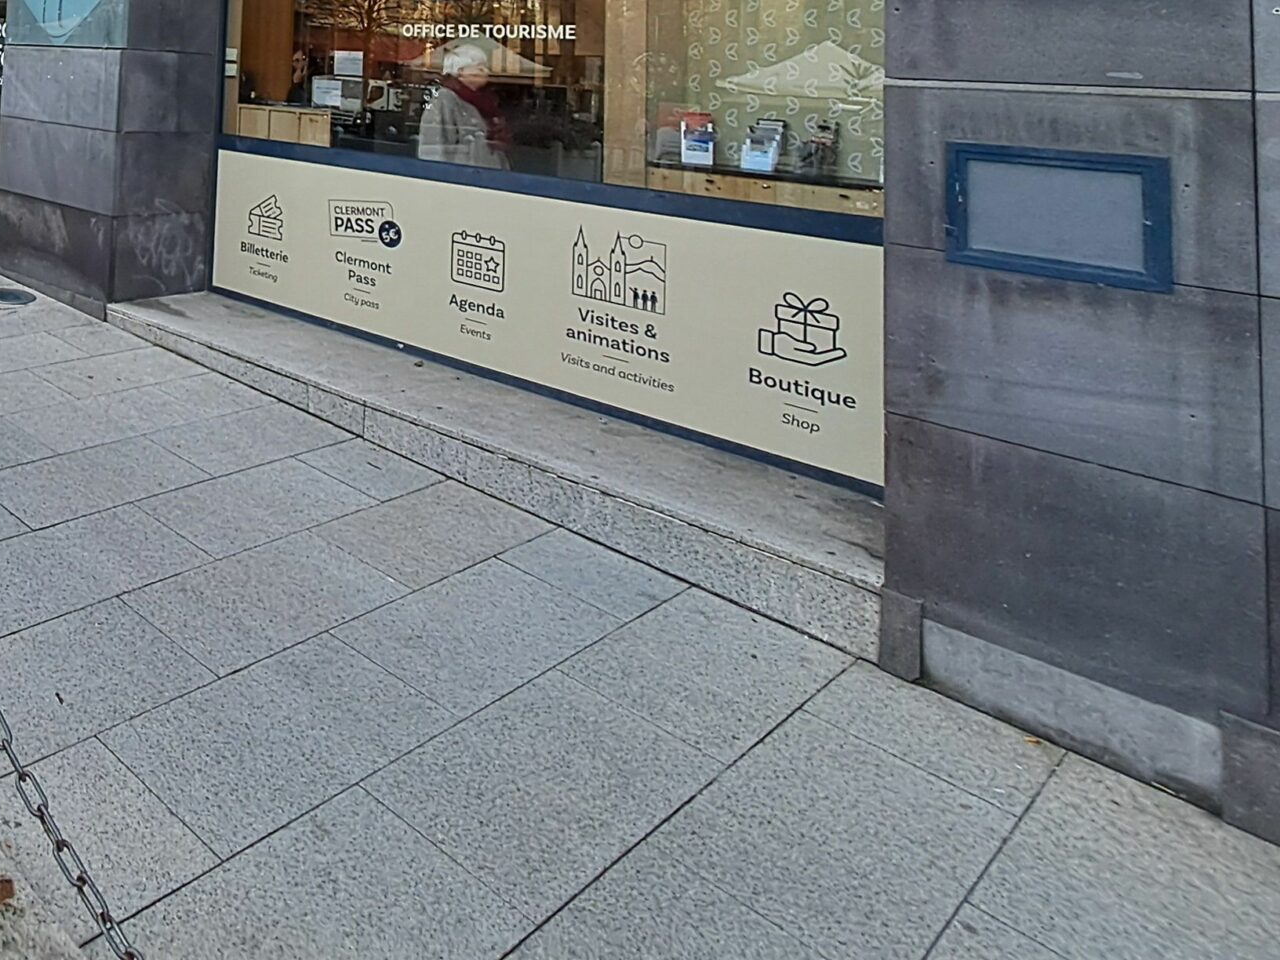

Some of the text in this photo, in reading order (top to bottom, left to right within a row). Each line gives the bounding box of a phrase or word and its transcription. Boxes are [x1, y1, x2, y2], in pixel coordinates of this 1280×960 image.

[401, 23, 577, 40] OFFICE DE TOURISME
[333, 205, 386, 218] CLERMONT
[334, 217, 375, 234] PASS
[240, 241, 289, 264] Billetterie
[334, 250, 392, 275] Clermont
[248, 266, 279, 283] Ticketing
[347, 269, 377, 287] Pass
[343, 292, 380, 310] City pass
[448, 293, 505, 319] Agenda
[459, 324, 492, 341] Events
[577, 307, 657, 339] Visites &
[565, 326, 671, 363] animations
[560, 352, 675, 393] Visits and activities
[748, 367, 857, 409] Boutique
[781, 413, 821, 434] Shop
